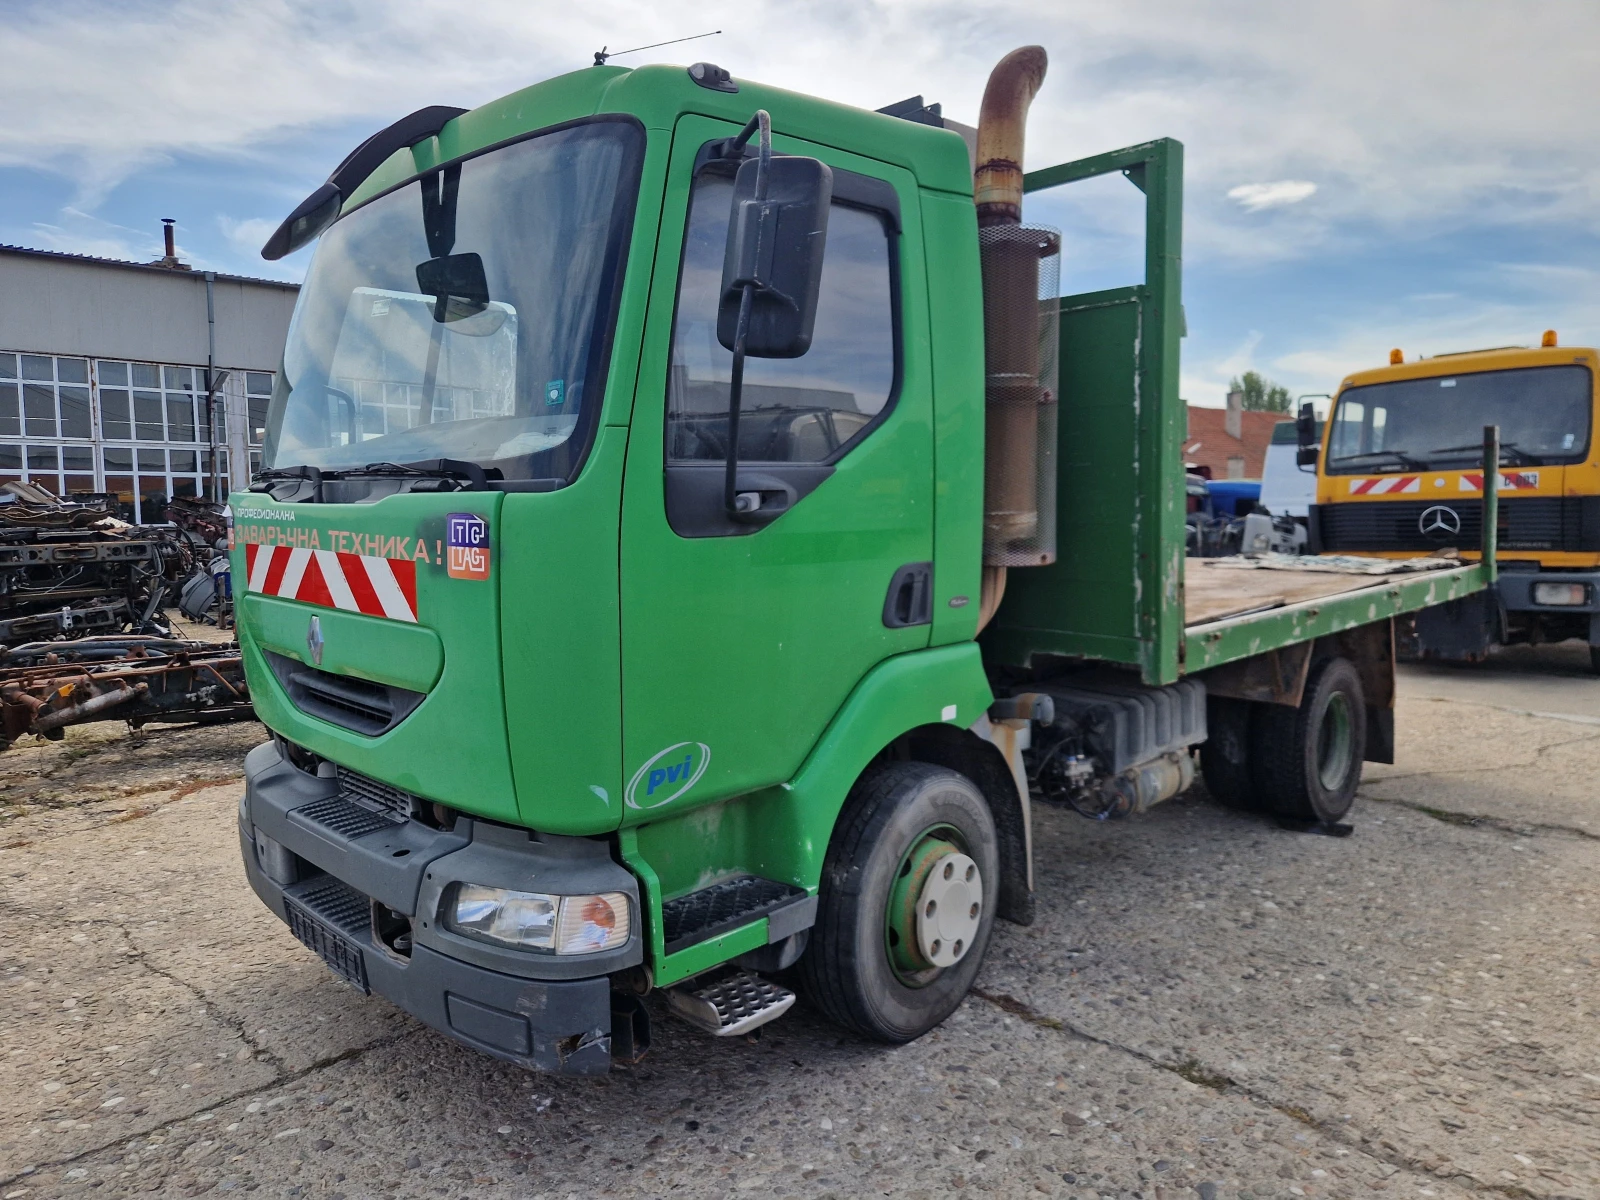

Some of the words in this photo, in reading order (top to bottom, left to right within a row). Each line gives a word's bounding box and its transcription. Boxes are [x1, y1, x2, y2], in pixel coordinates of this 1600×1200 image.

[237, 507, 296, 522] ПРОФЕСИОНАЛНА
[455, 519, 481, 544] TIG
[236, 524, 321, 549] ЗАВАРЪЧНА
[328, 529, 430, 565] ТЕХНИКА
[455, 546, 482, 569] TAG
[646, 754, 693, 796] pvi
